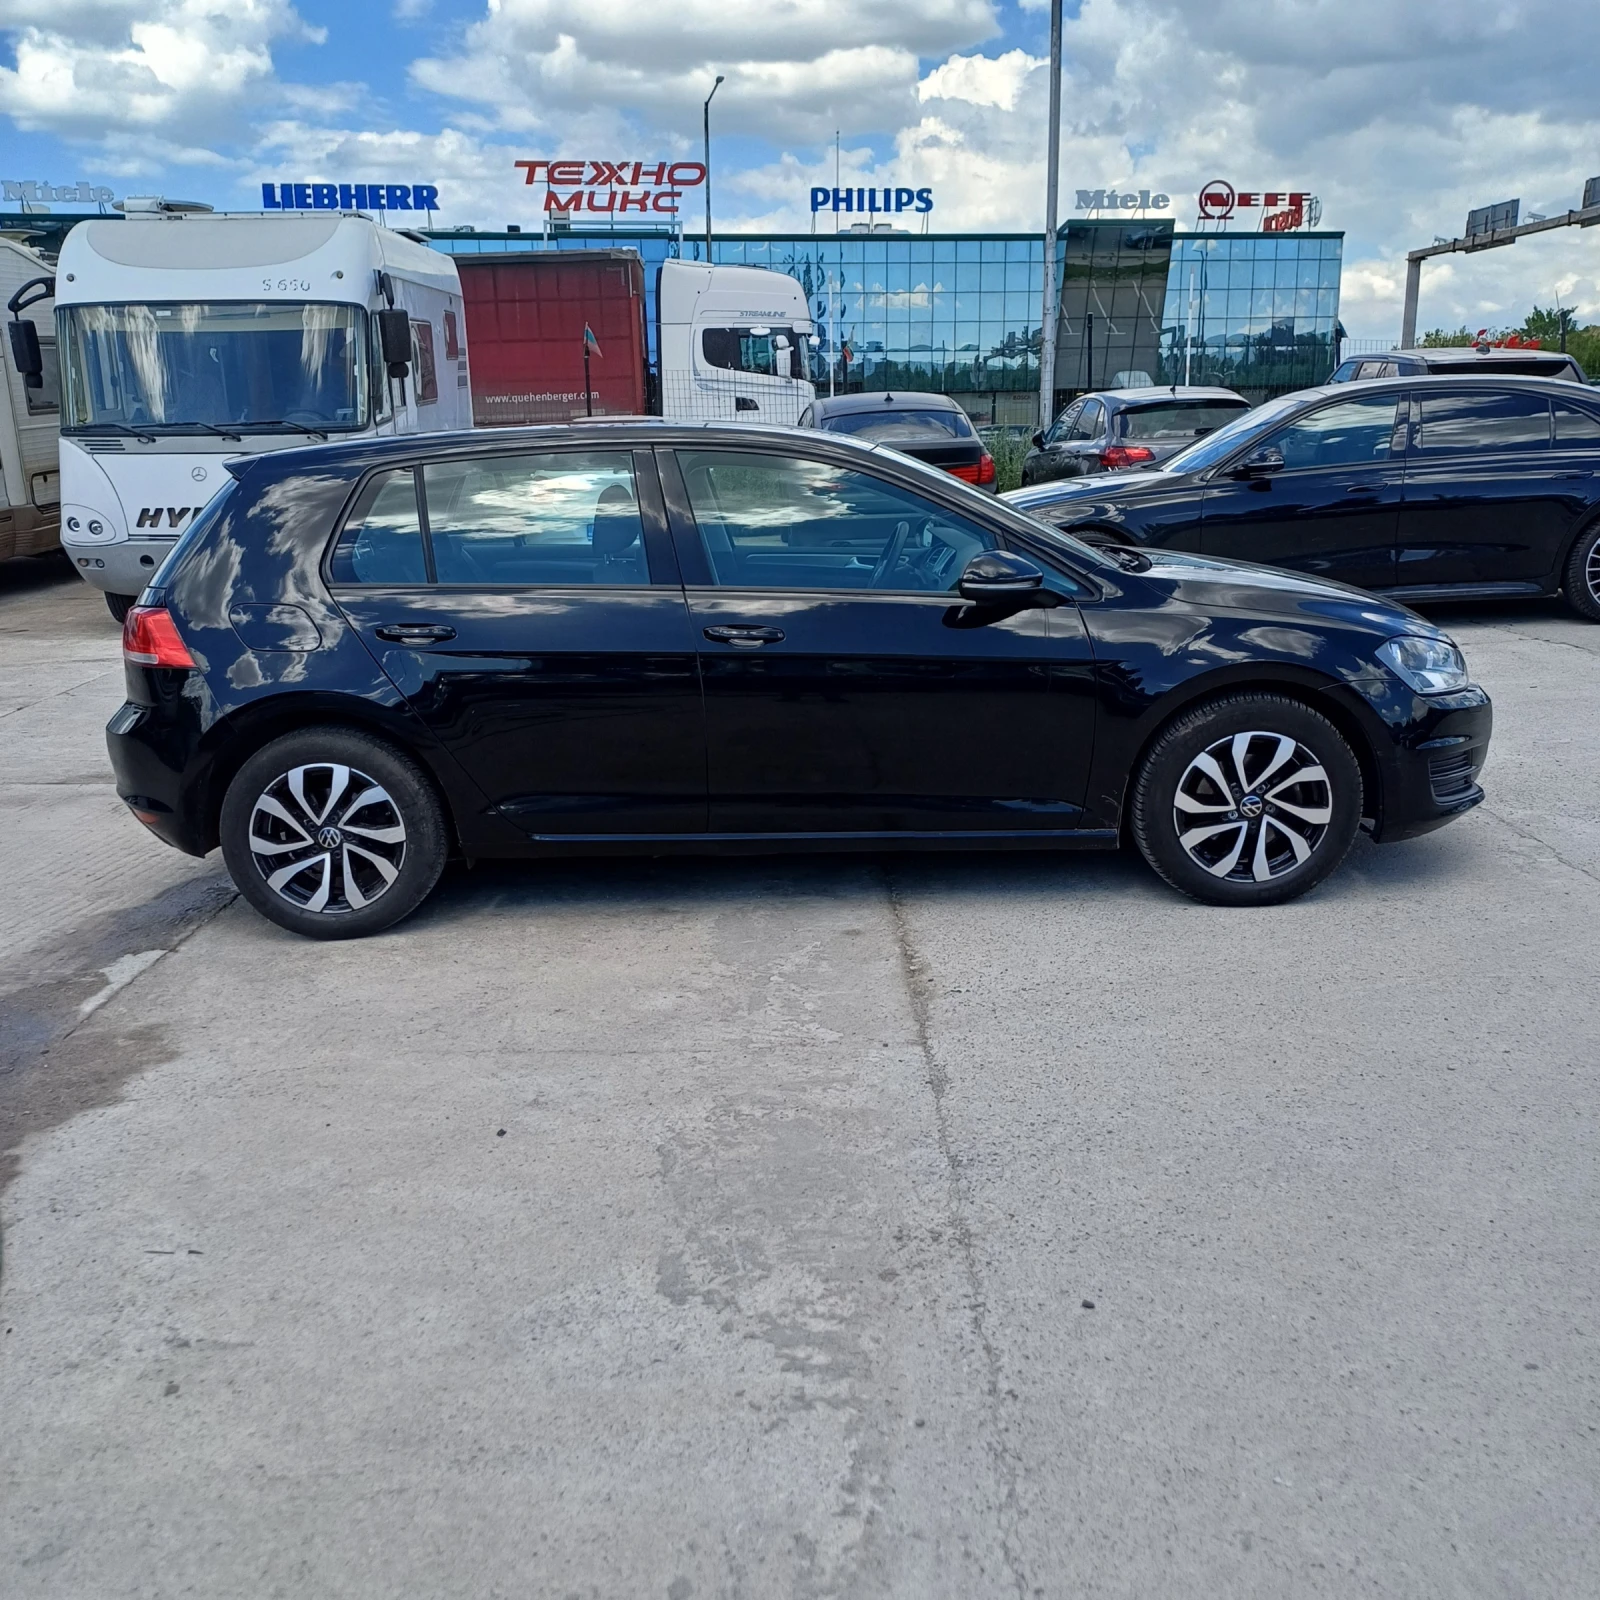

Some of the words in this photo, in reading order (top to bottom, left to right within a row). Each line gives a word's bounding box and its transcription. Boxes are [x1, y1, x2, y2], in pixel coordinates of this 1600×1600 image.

[1, 180, 115, 203] Miele
[262, 183, 441, 211] LIEBHERR
[810, 187, 934, 213] PHILIPS
[1075, 189, 1170, 210] Miele
[739, 310, 787, 318] STREAMLINE
